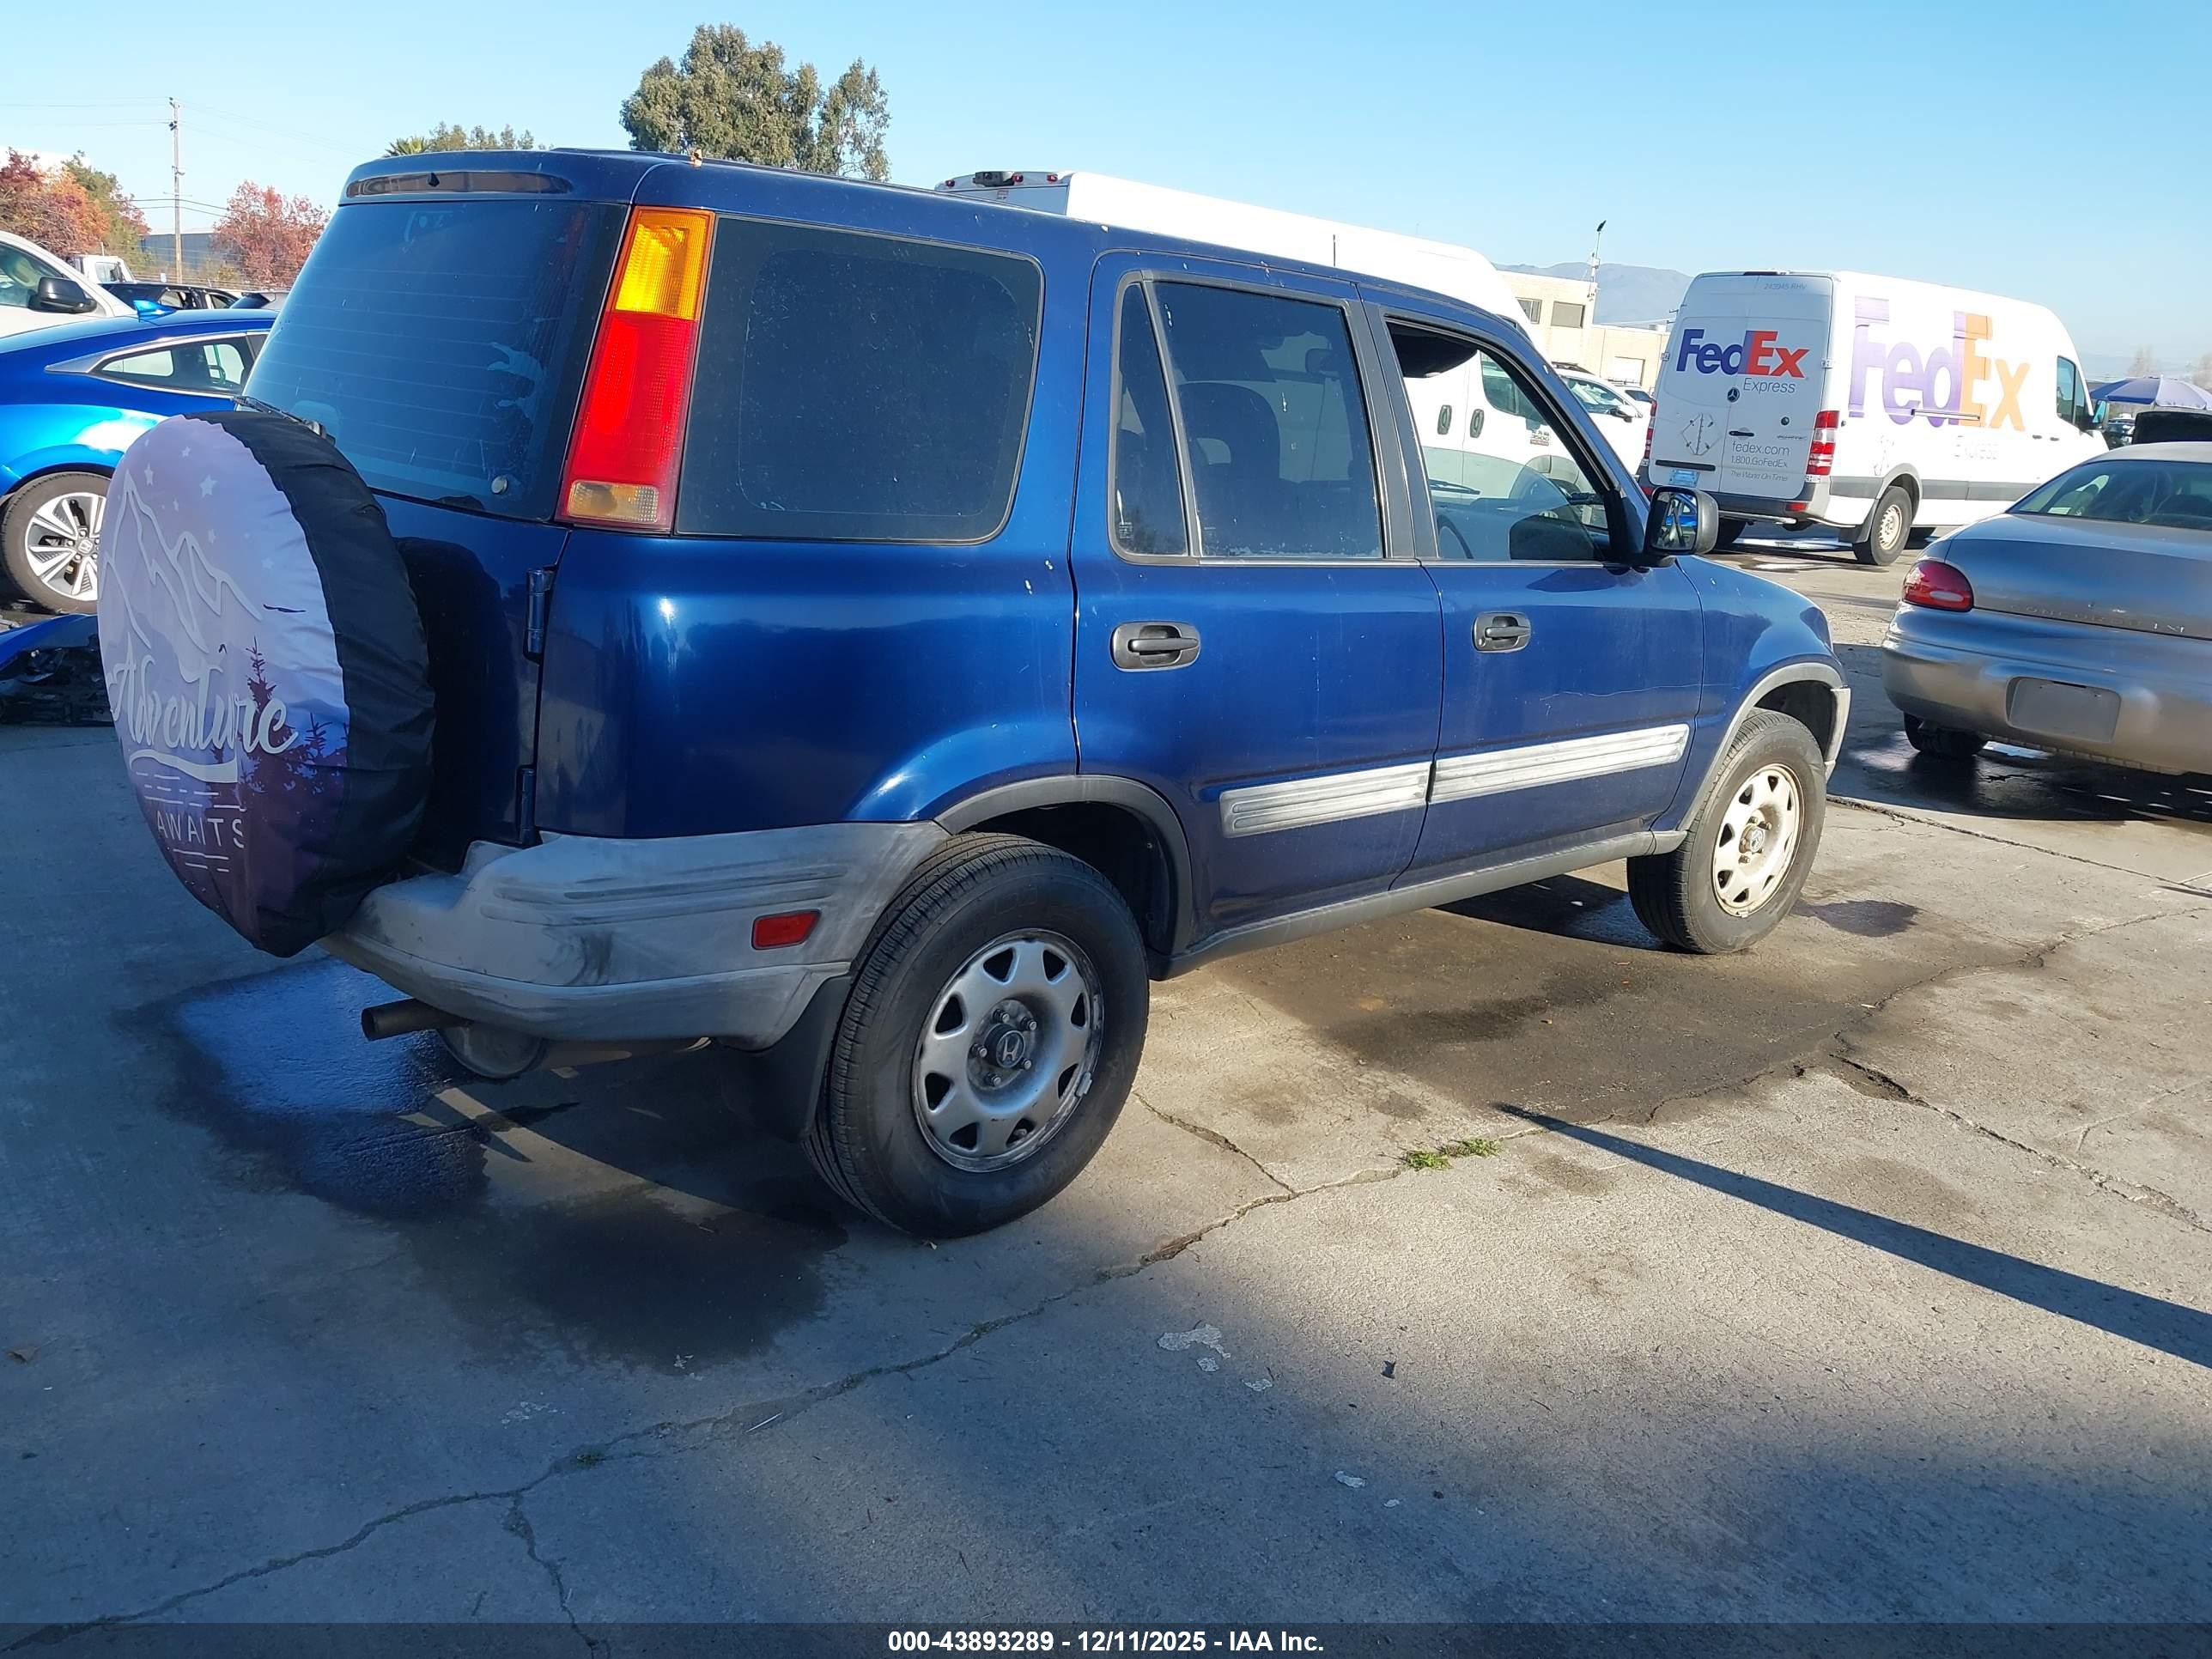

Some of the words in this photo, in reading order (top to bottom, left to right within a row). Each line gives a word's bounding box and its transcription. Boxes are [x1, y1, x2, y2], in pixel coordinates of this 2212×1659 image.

[1676, 329, 1810, 379] FedEx
[1848, 295, 2032, 432] FedEx
[1743, 378, 1796, 393] Express
[1732, 441, 1790, 456] fedex.com
[1772, 473, 1788, 482] Time
[105, 633, 299, 755] Adventure
[156, 810, 245, 848] AWAITS
